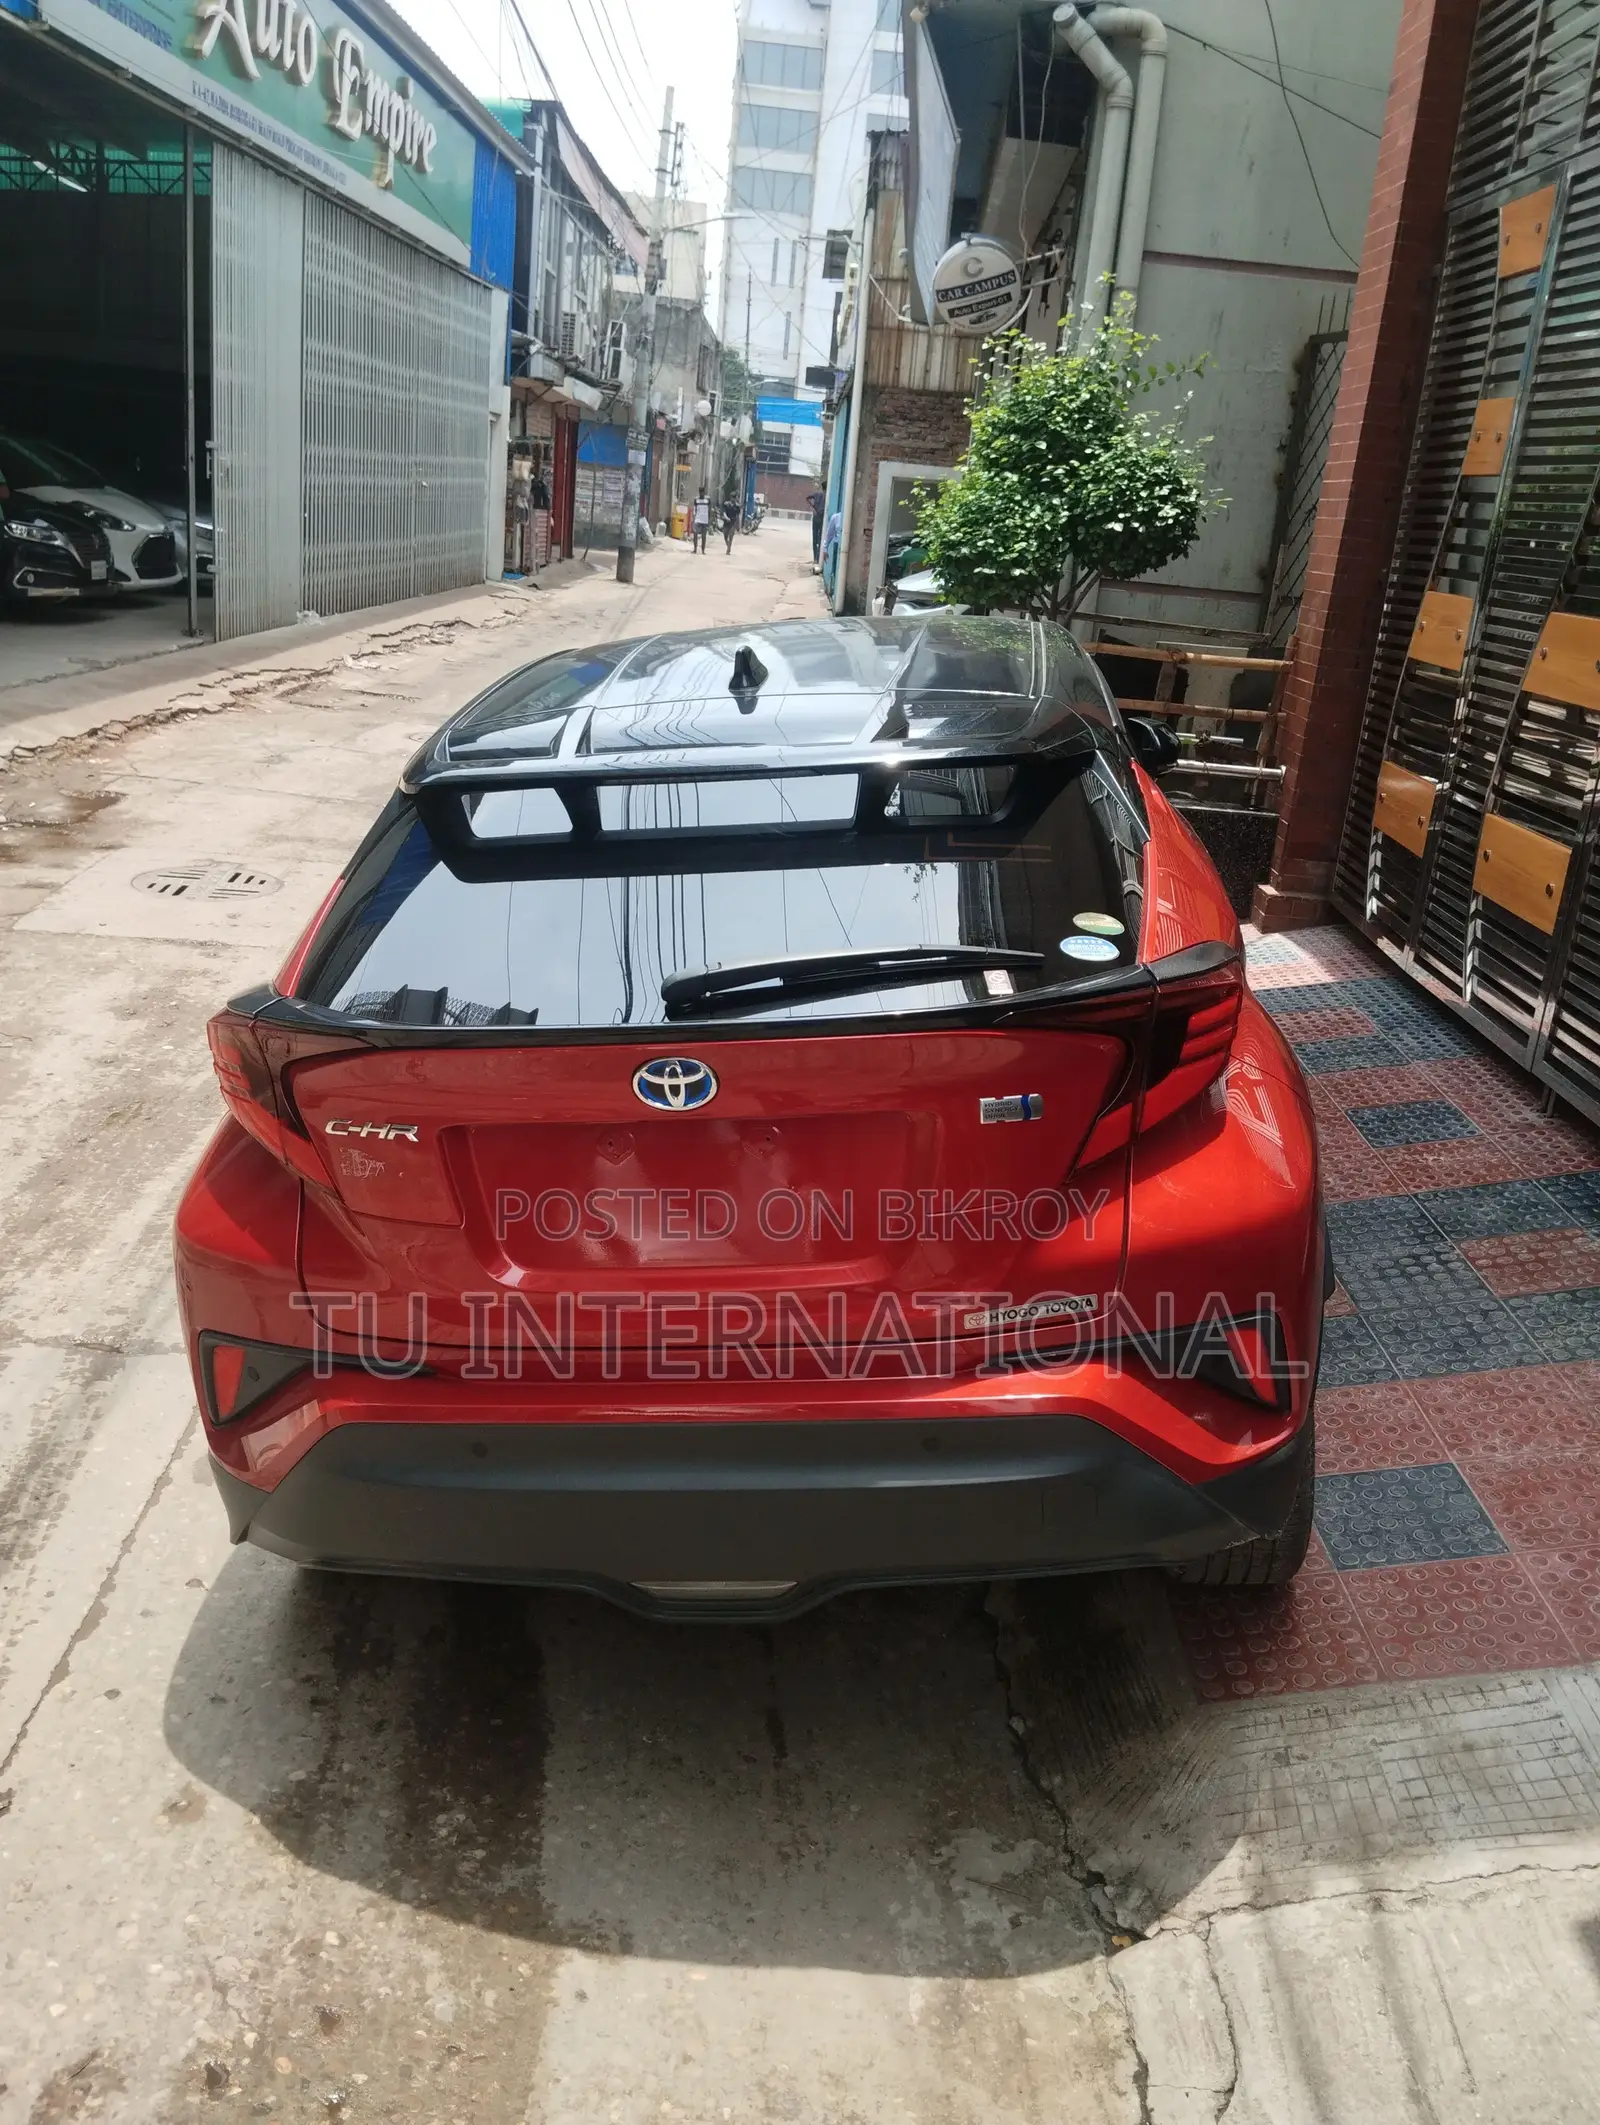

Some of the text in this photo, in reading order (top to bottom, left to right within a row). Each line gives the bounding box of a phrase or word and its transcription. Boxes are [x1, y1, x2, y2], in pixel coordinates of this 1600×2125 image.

[194, 0, 437, 190] Auto Empire
[938, 287, 964, 302] CAR
[964, 271, 1015, 298] CAMPUS
[953, 306, 972, 317] Auto
[984, 1100, 1013, 1108] HYBRID
[984, 1105, 1019, 1113] SYNERGY
[325, 1118, 419, 1142] C-HR
[989, 1297, 1094, 1323] HYOGO TOYOTA
